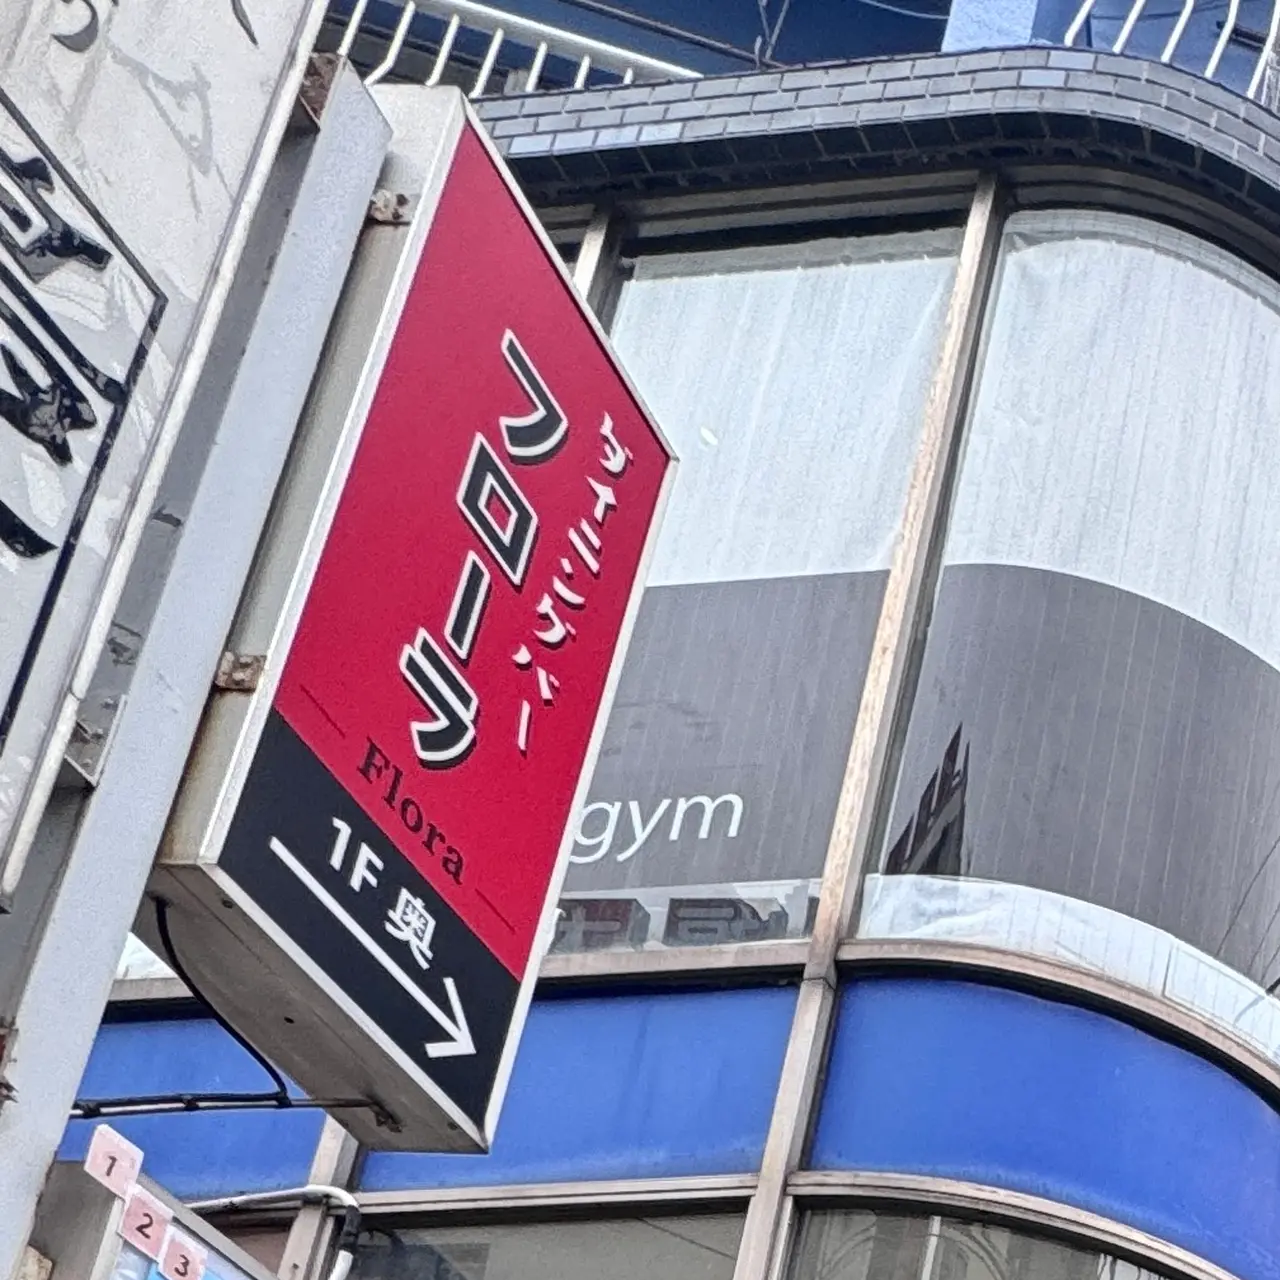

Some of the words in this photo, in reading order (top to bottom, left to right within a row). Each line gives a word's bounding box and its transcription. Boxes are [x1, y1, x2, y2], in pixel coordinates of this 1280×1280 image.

[400, 328, 568, 763] フローラ
[511, 409, 633, 753] ダイニングバー
[357, 736, 465, 885] Flora
[569, 793, 744, 864] gym
[385, 885, 435, 970] 奥
[138, 1212, 156, 1239] 2
[173, 1254, 190, 1278] 3
